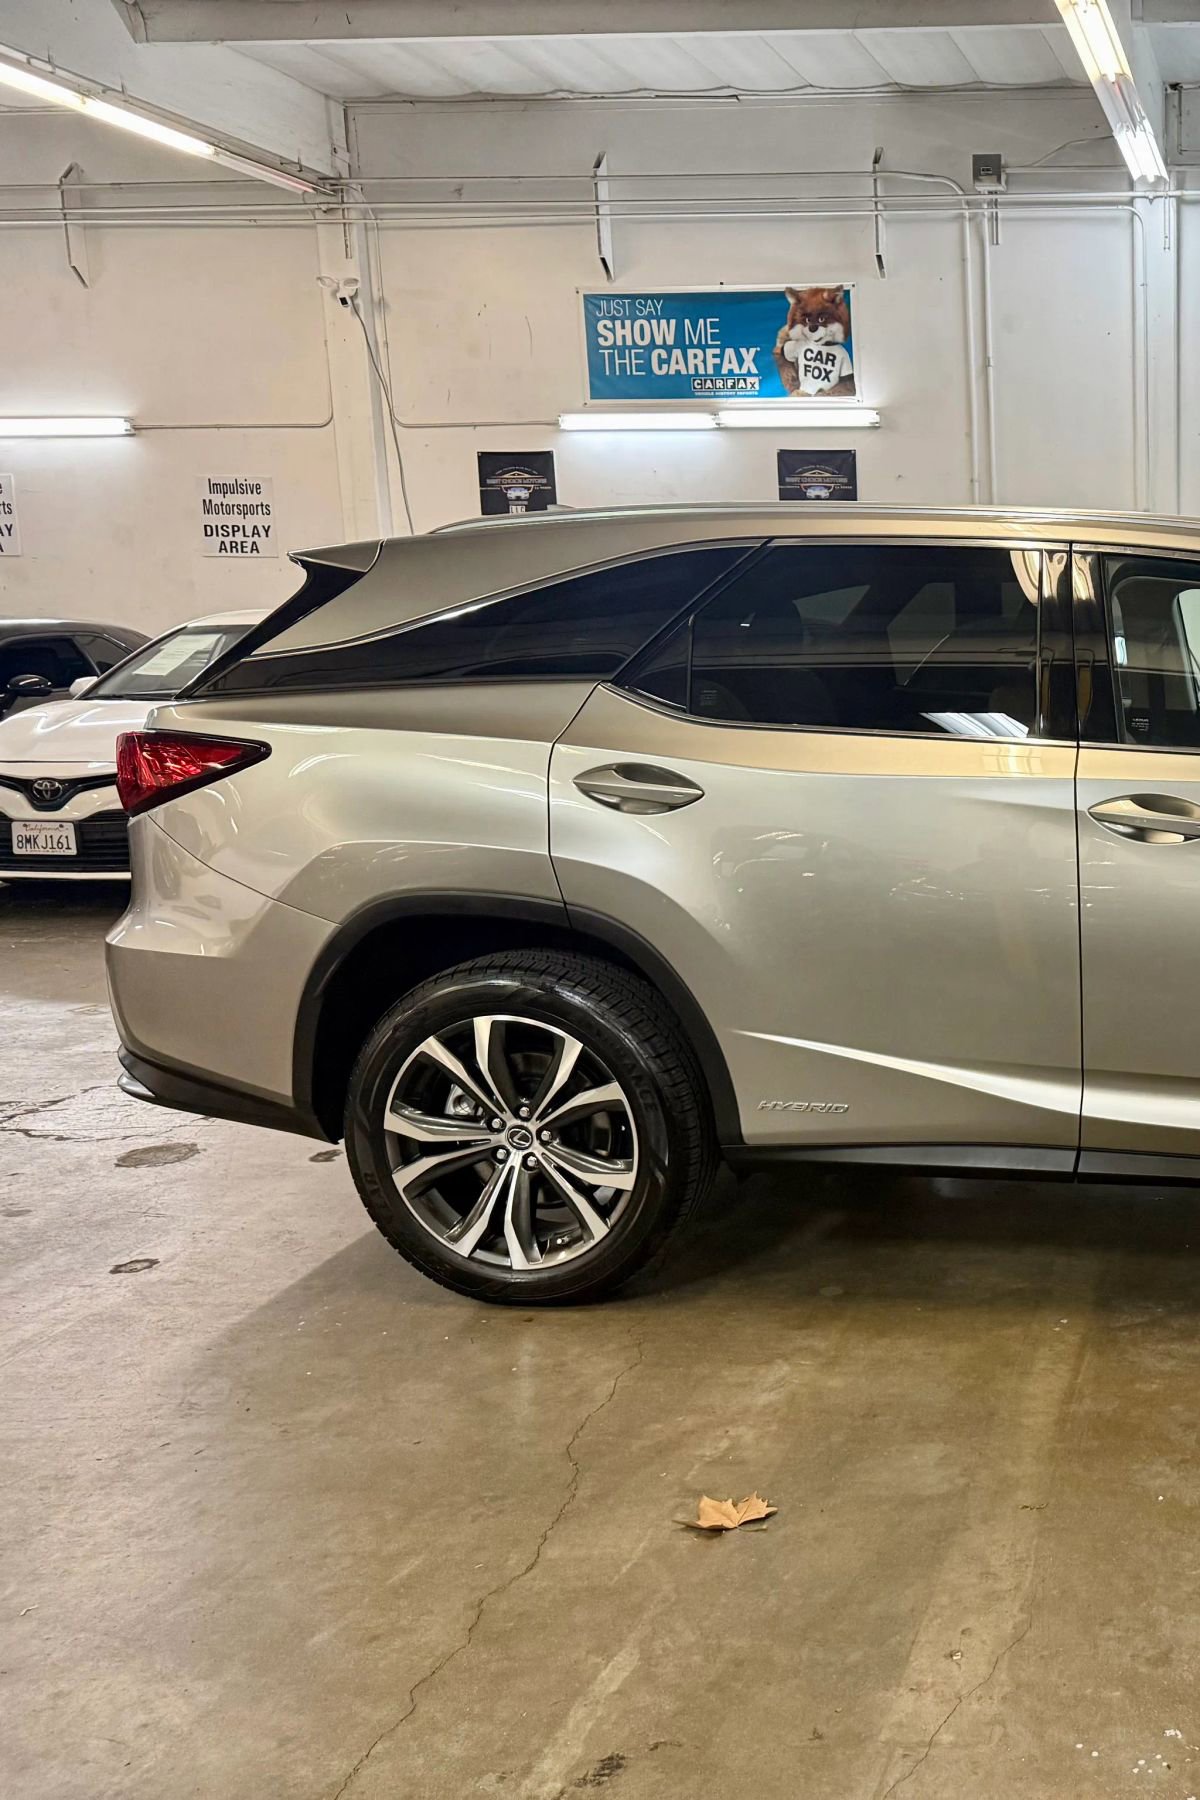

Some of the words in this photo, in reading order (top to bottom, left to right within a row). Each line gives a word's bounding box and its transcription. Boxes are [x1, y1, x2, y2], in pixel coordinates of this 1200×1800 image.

[596, 299, 631, 317] JUST
[635, 299, 663, 316] SAY
[597, 319, 676, 346] SHOW
[684, 318, 720, 345] ME
[599, 349, 646, 375] THE
[651, 347, 759, 375] CARFAX
[804, 348, 836, 367] CAR
[804, 364, 833, 383] FOX
[692, 378, 757, 390] CARFAX
[208, 478, 262, 499] Impulsive
[202, 499, 271, 520] Motorsports
[203, 524, 271, 538] DISPLAY
[218, 540, 260, 554] AREA
[16, 834, 72, 850] 8MKJ161
[757, 1100, 849, 1113] HYBRID
